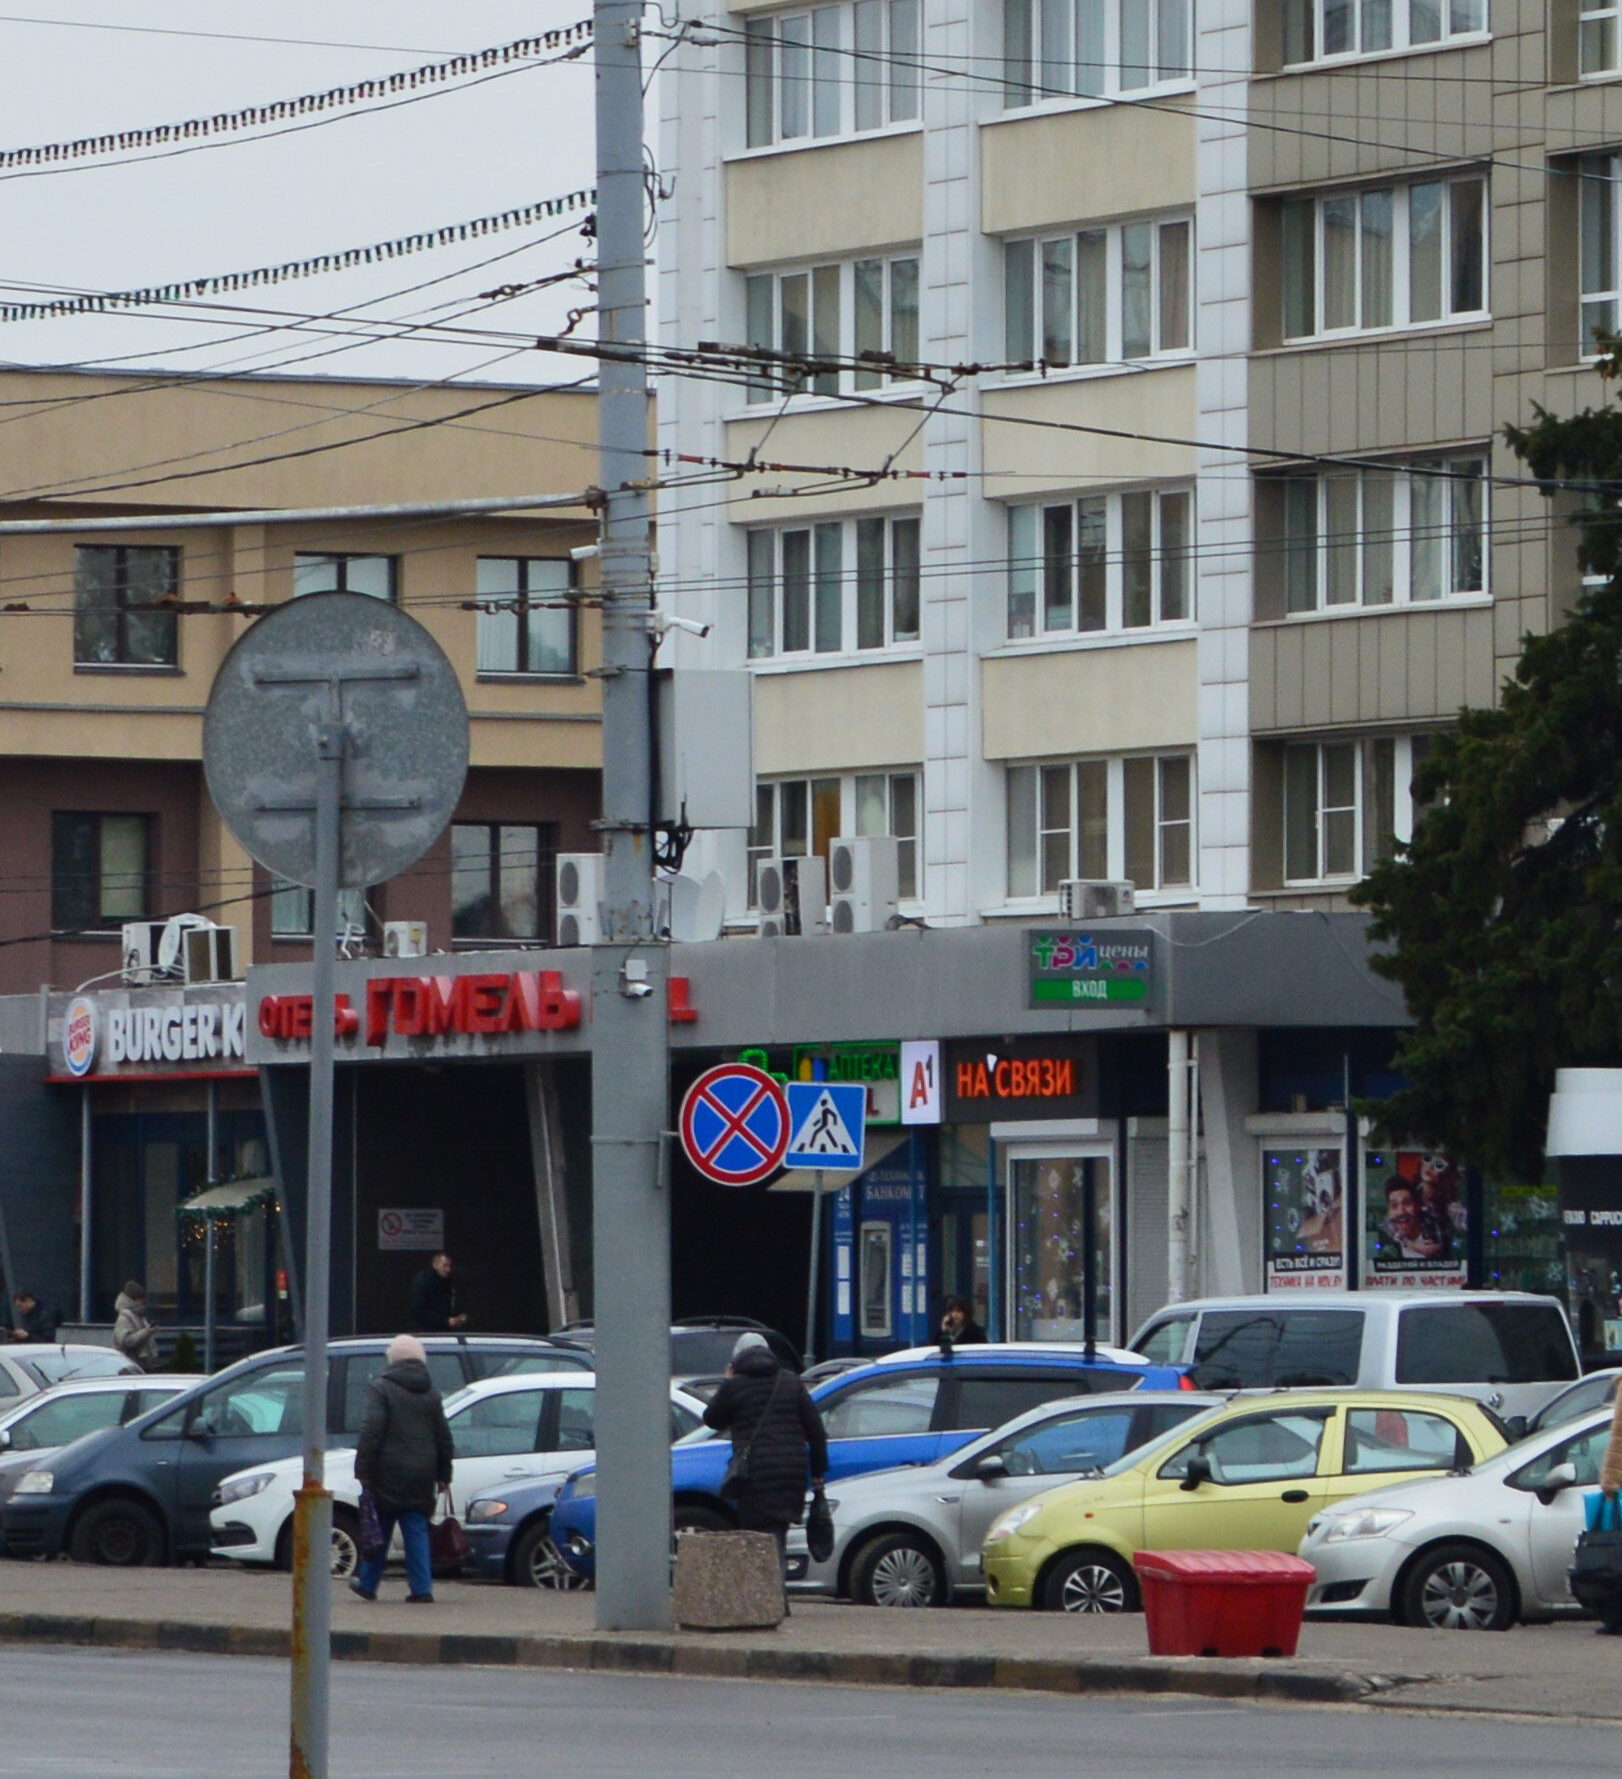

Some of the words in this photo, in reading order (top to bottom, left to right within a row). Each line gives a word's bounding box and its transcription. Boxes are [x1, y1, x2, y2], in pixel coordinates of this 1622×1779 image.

[259, 994, 358, 1038] ОТЕЬ
[366, 970, 581, 1047] ГОМЕЛЬ
[1072, 980, 1108, 998] ВХОД
[109, 1004, 219, 1063] BURGER
[829, 1053, 897, 1082] АПТЕКА
[956, 1062, 989, 1099] НА
[995, 1059, 1071, 1097] СВЯЗИ
